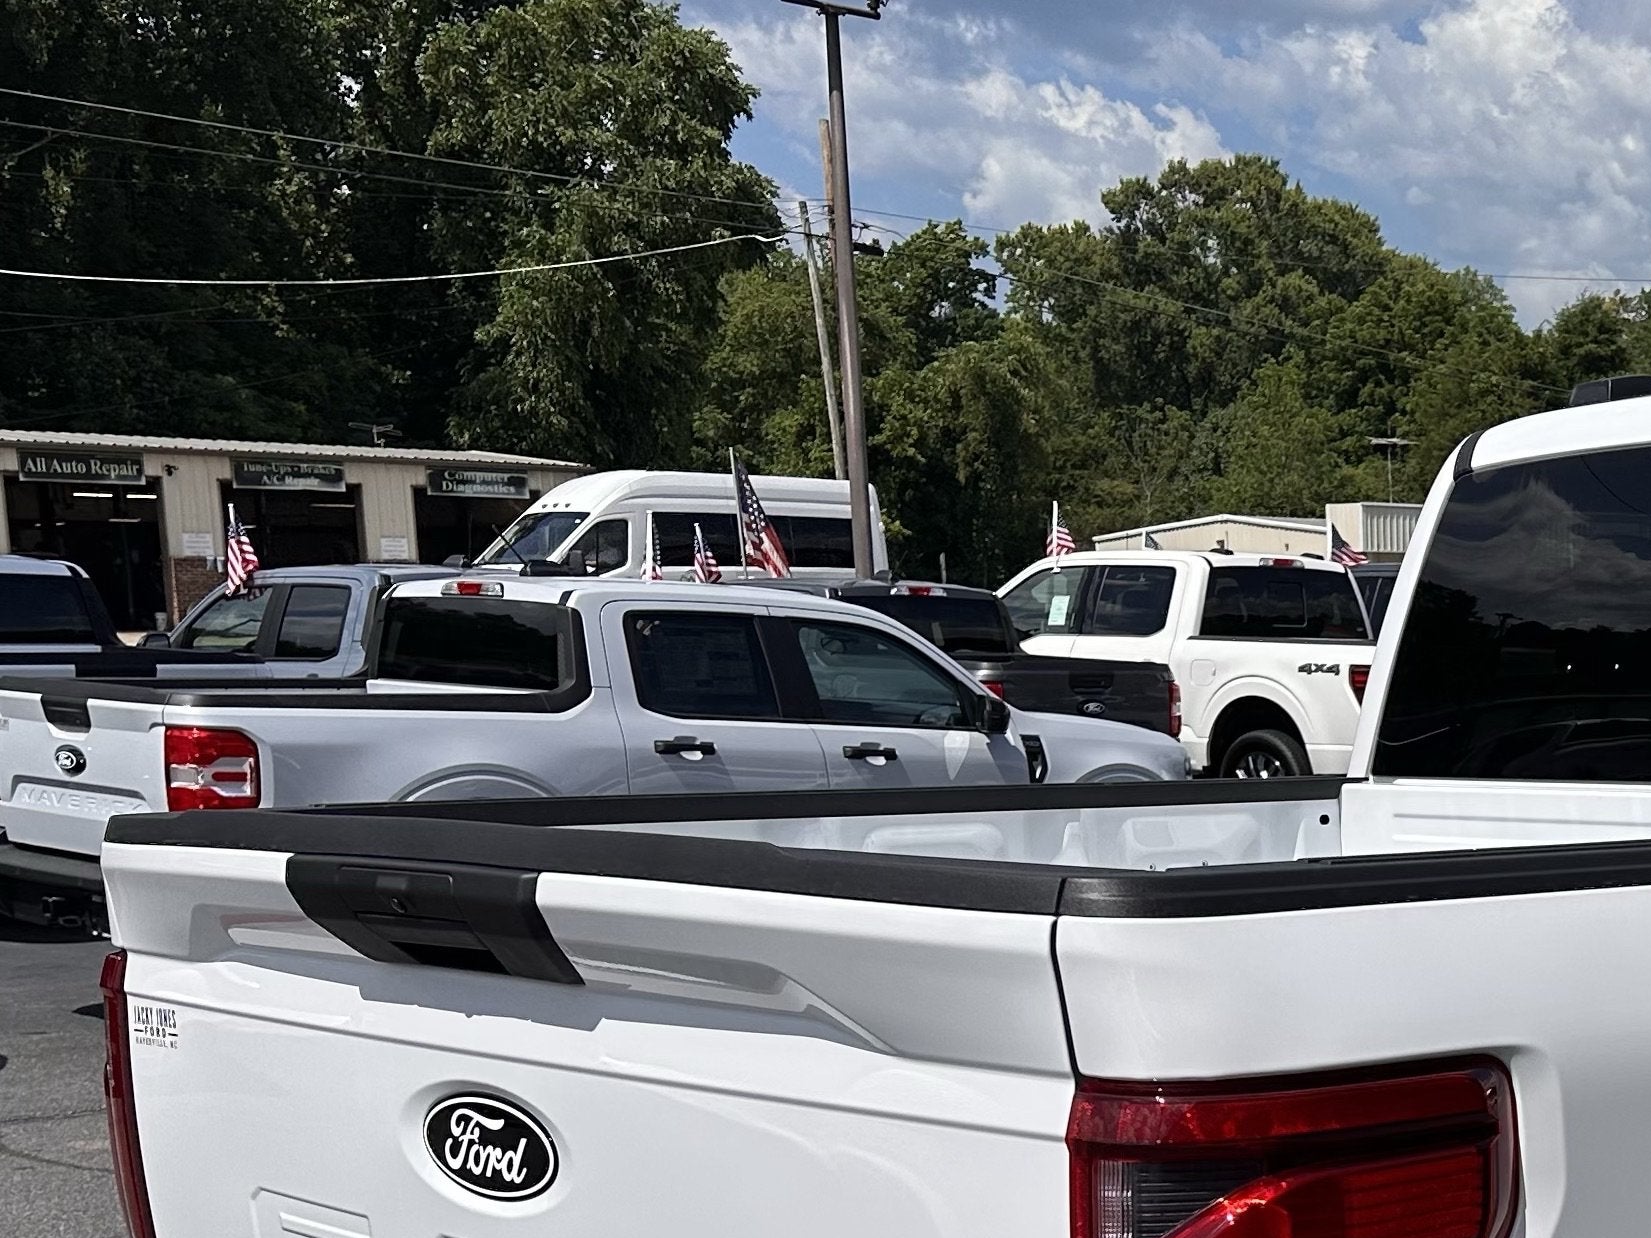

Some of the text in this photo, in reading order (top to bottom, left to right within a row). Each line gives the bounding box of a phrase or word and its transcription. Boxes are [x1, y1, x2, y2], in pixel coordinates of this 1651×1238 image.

[24, 457, 140, 479] All Auto Repair
[261, 474, 320, 487] A/C Repair
[443, 470, 508, 483] Computer
[442, 480, 516, 494] Diagnostics
[133, 1005, 177, 1029] JACKY JONES
[144, 1025, 167, 1039] FORD
[444, 1107, 528, 1184] Ford
